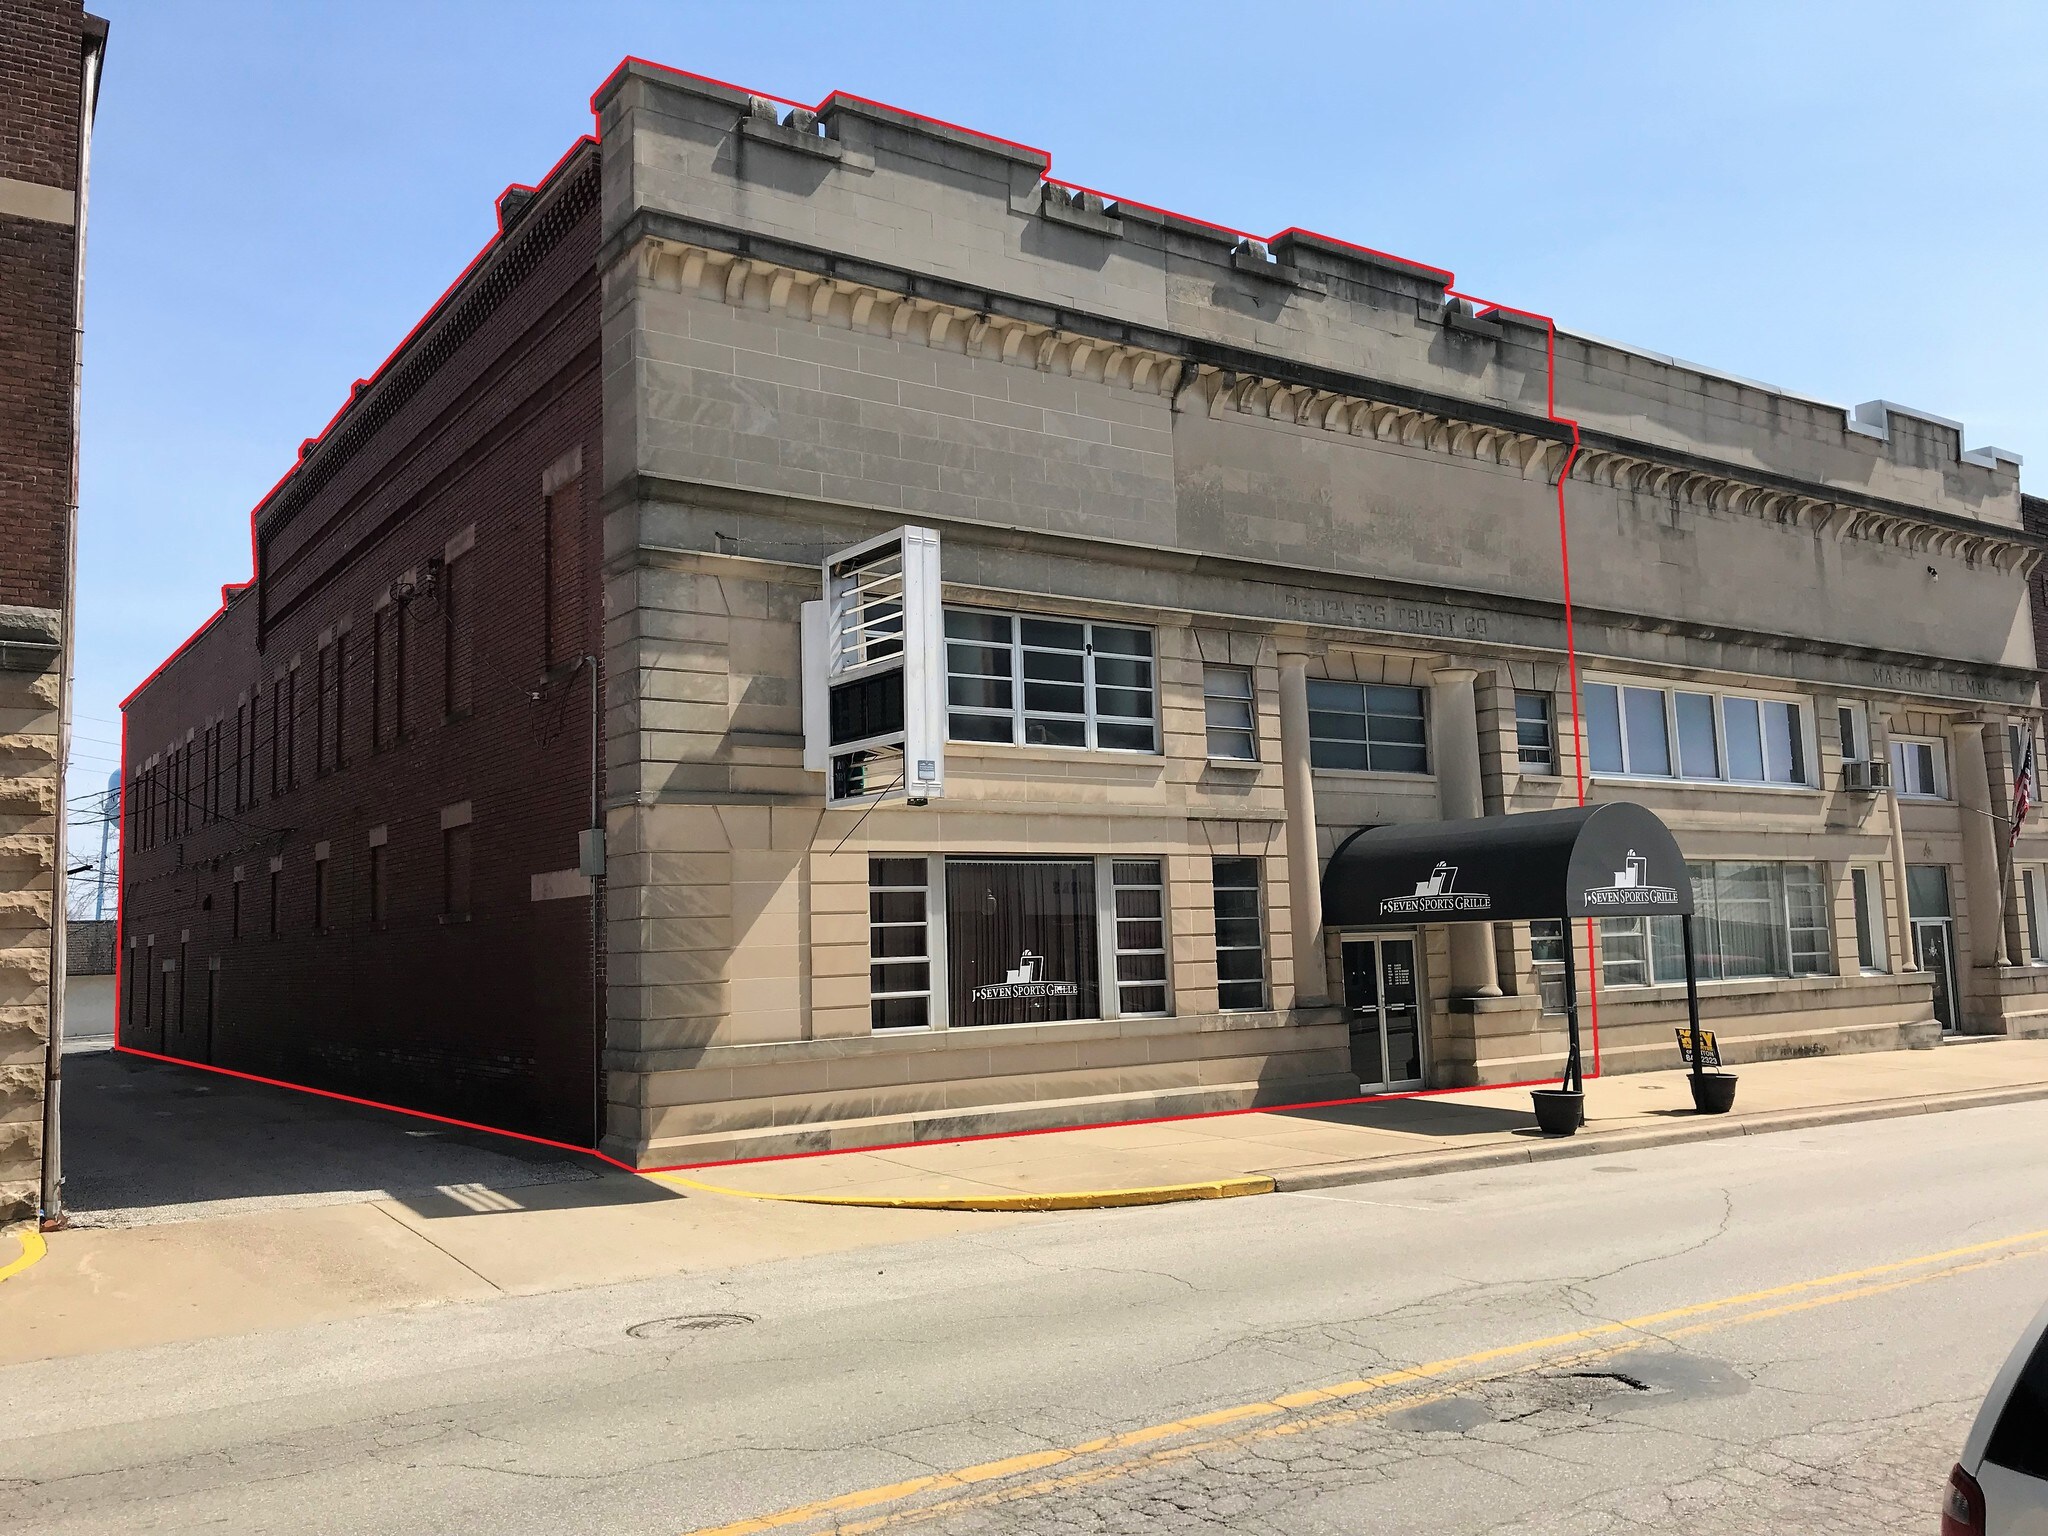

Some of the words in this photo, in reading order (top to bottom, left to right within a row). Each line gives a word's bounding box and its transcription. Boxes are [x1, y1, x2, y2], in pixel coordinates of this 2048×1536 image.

[1394, 606, 1456, 632] TRUST
[1463, 615, 1488, 635] CO
[1872, 667, 1937, 689] MASONIC
[1949, 677, 2002, 697] TEMPLE
[1419, 897, 1453, 912] SPORTS
[1455, 896, 1491, 910] GRILLE
[1620, 887, 1649, 904] SPORTS
[1650, 888, 1678, 903] GRILLE
[1012, 984, 1045, 998] SPORTS
